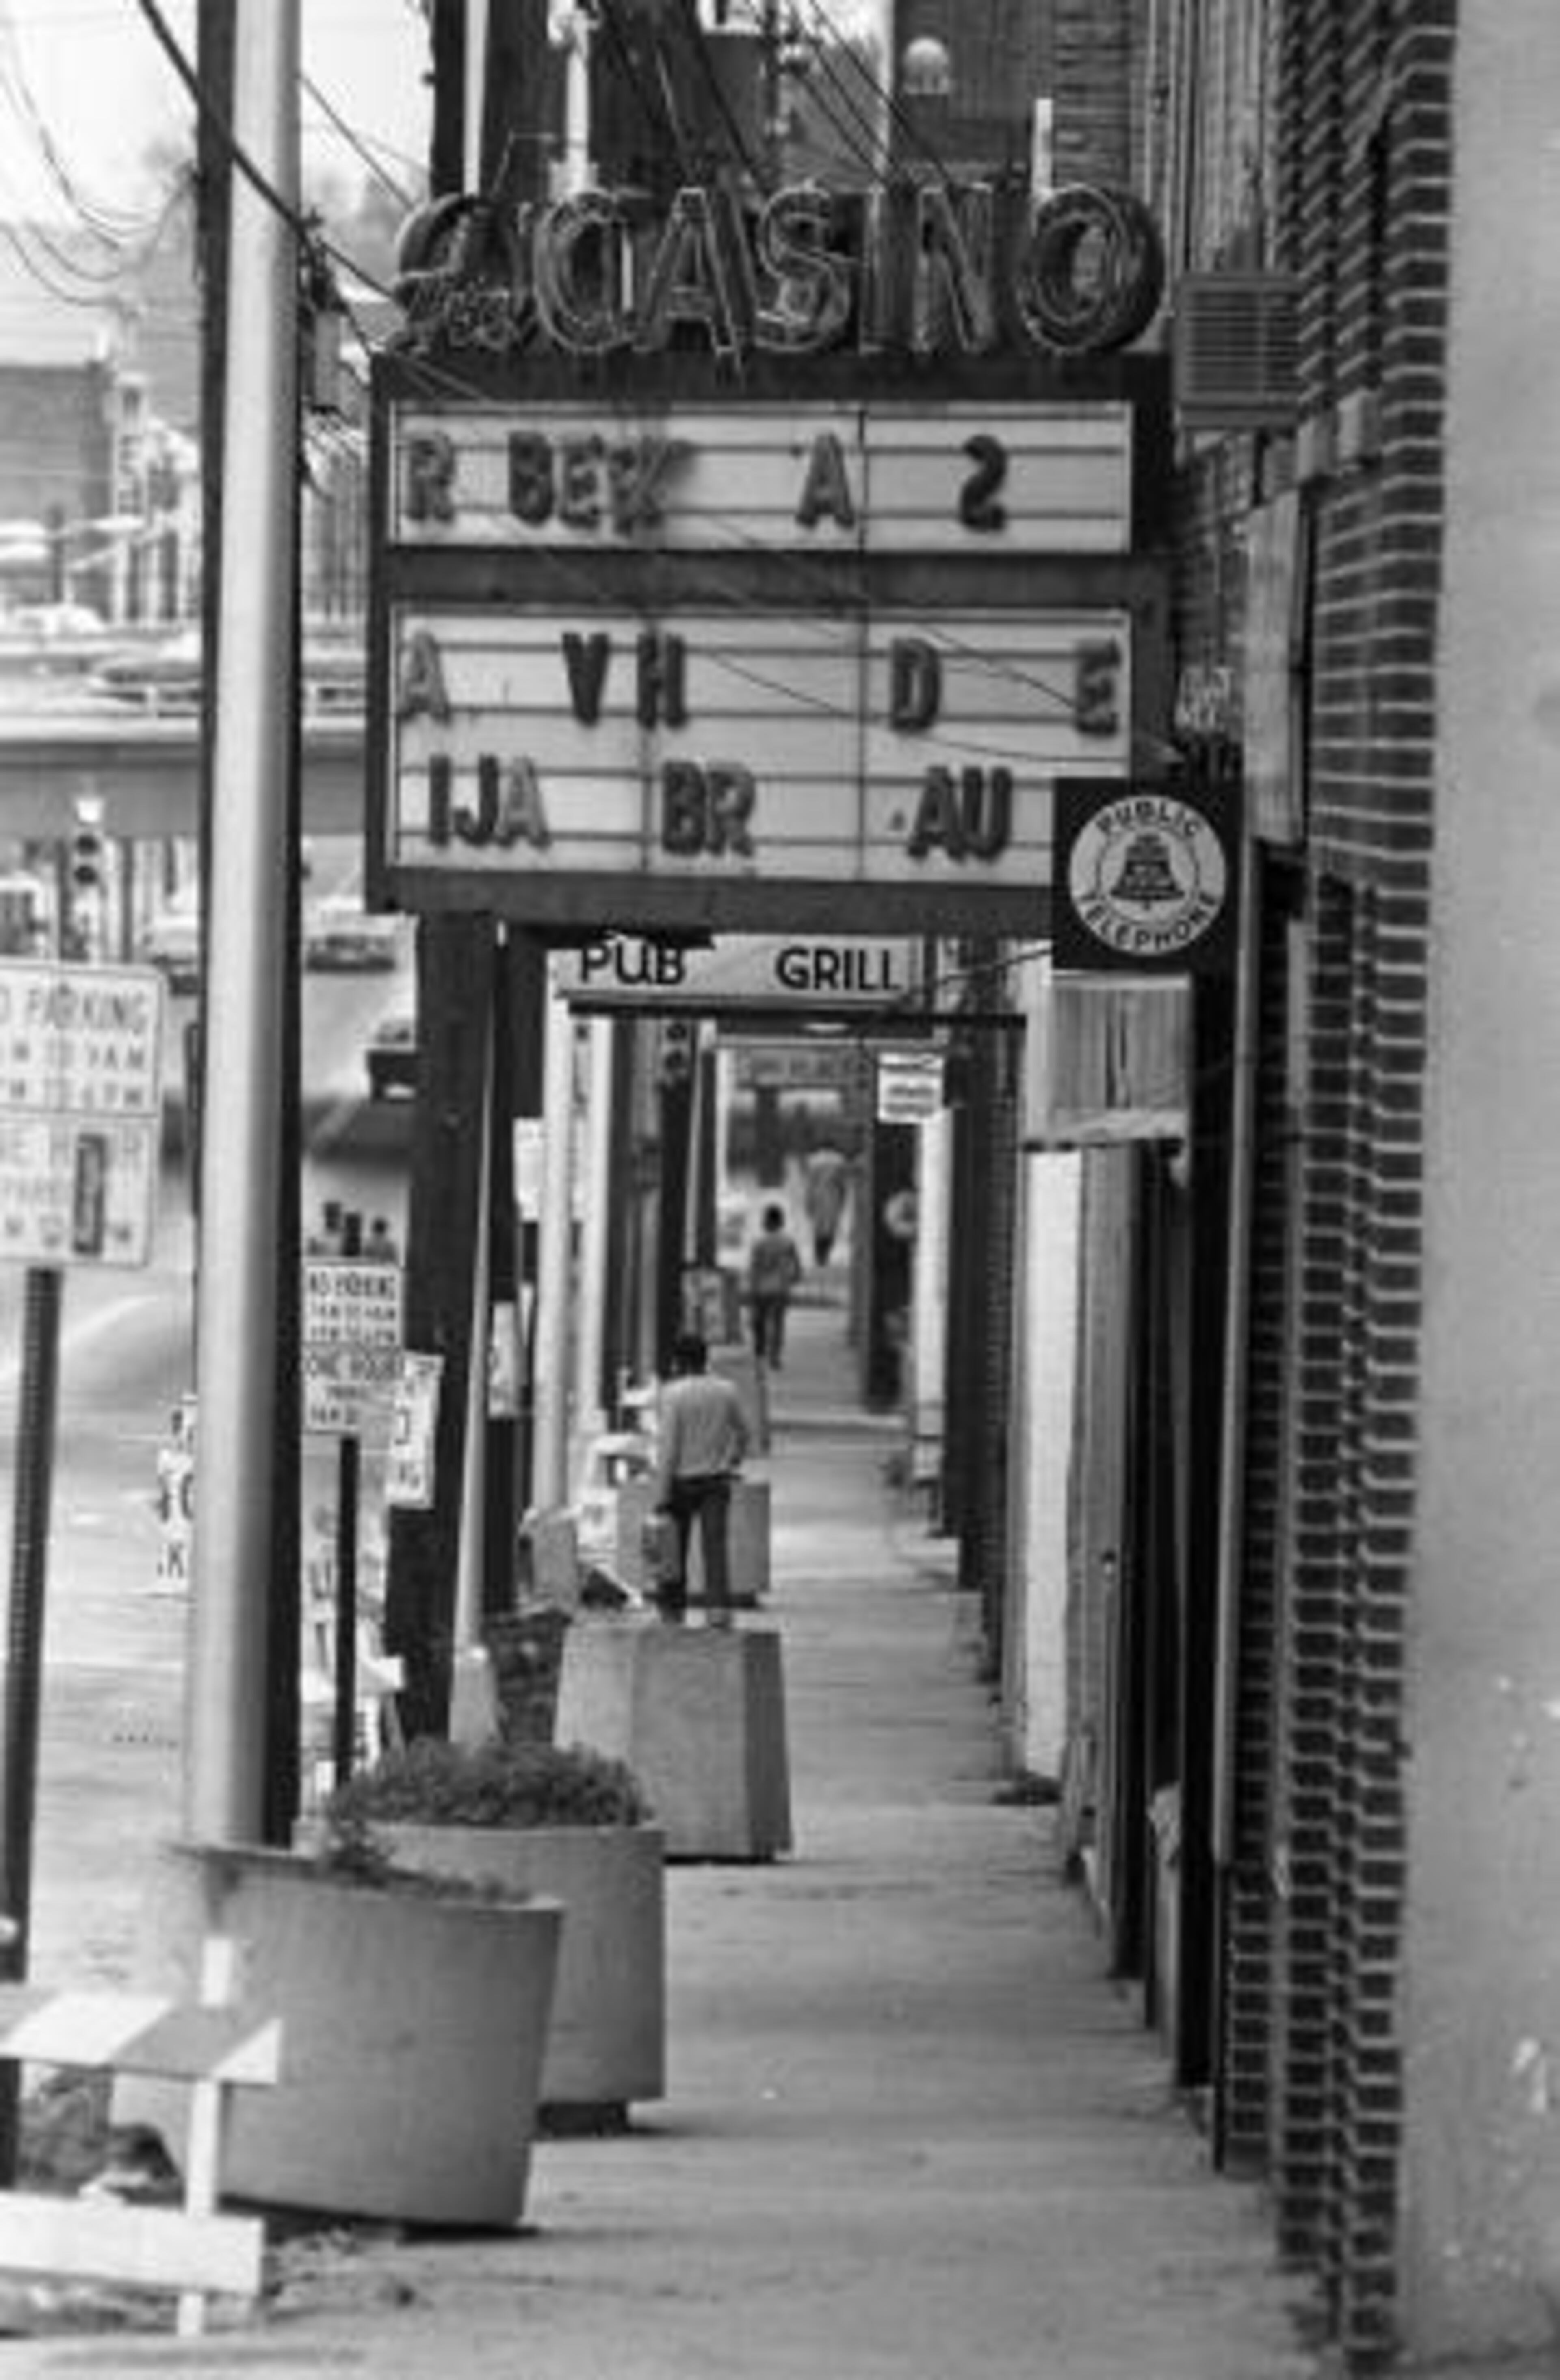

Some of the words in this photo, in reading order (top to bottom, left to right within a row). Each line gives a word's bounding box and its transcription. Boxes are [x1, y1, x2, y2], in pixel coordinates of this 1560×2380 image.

[533, 184, 1164, 367] CASINO
[795, 433, 856, 530] A
[404, 629, 450, 725] A
[890, 638, 941, 735] D
[662, 760, 755, 857] BR
[1096, 799, 1201, 837] PUBLIC
[578, 938, 687, 986] PUB
[775, 947, 903, 991] GRILL
[1079, 892, 1217, 950] TELEPHONE
